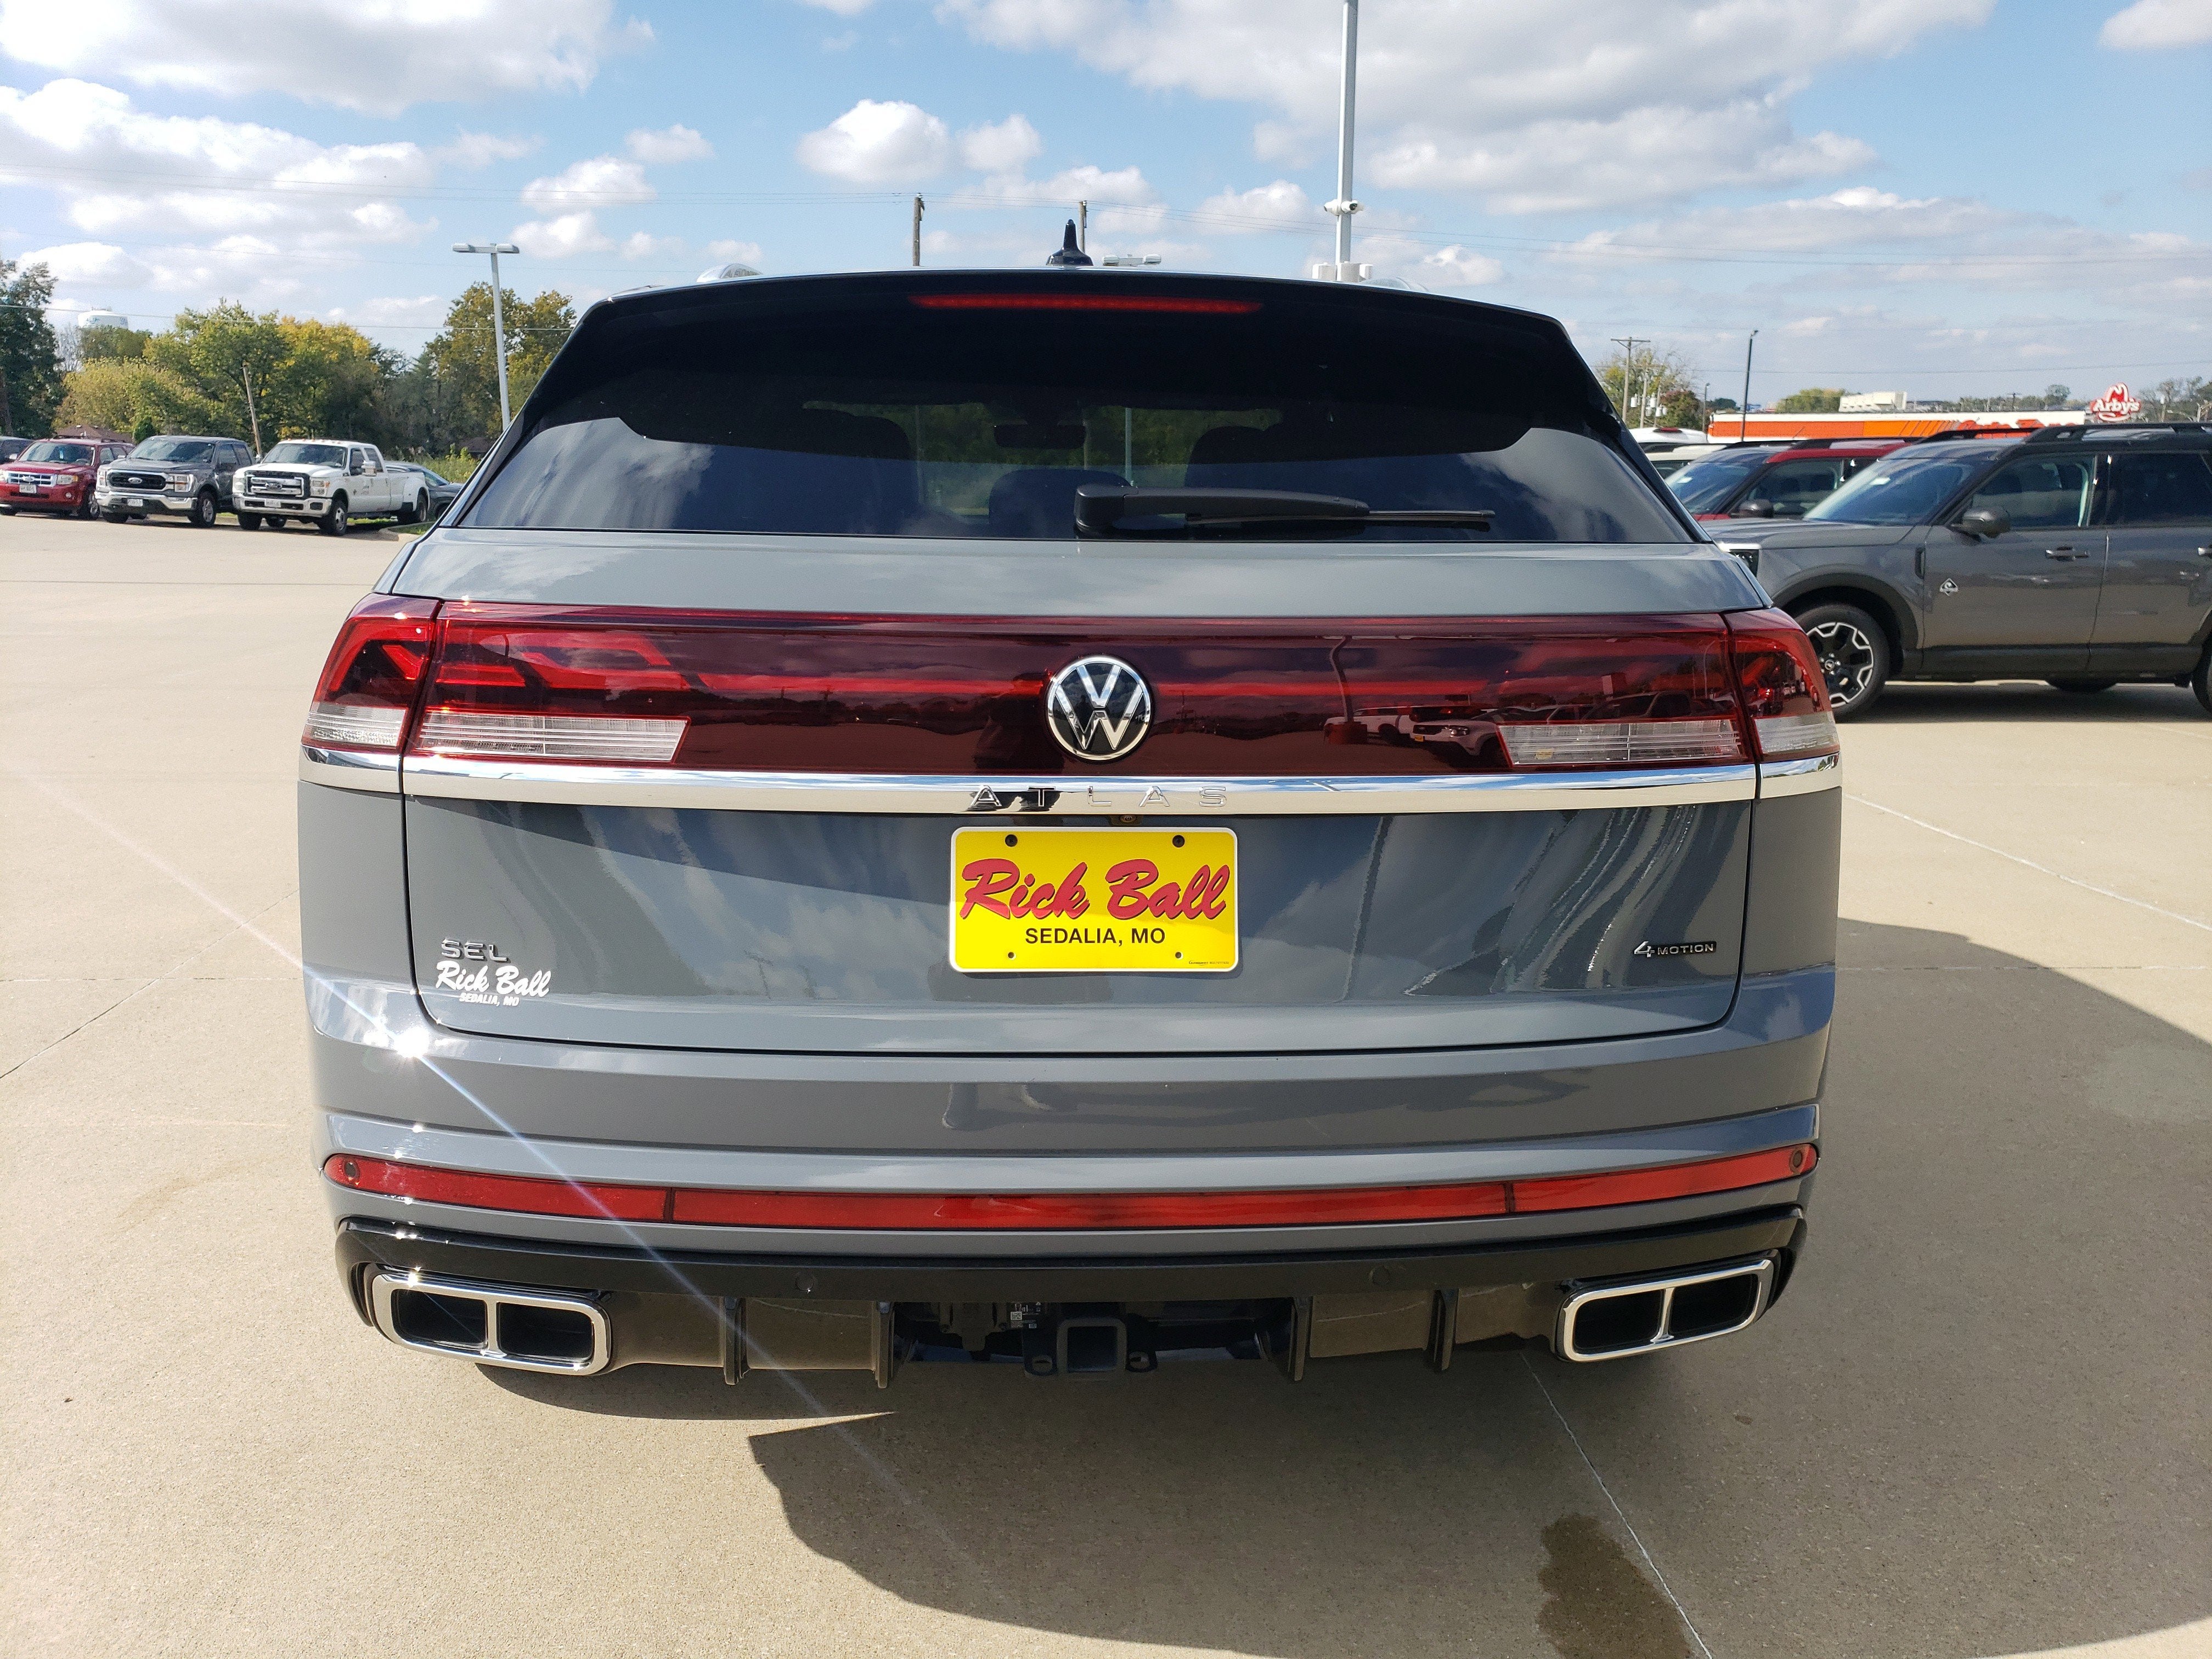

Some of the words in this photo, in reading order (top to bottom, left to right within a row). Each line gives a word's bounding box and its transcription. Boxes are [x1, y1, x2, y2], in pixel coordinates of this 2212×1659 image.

[2092, 398, 2140, 415] Arby's
[970, 784, 1227, 808] ATLAS
[960, 857, 1090, 920] Rick
[1104, 859, 1231, 921] Ball
[1025, 927, 1124, 947] SEDALIA,
[1131, 927, 1166, 944] MO
[441, 938, 509, 962] SEL
[436, 960, 490, 992] Rick
[495, 965, 551, 997] Ball
[459, 992, 500, 1007] SEDALIA,
[503, 996, 520, 1007] MO
